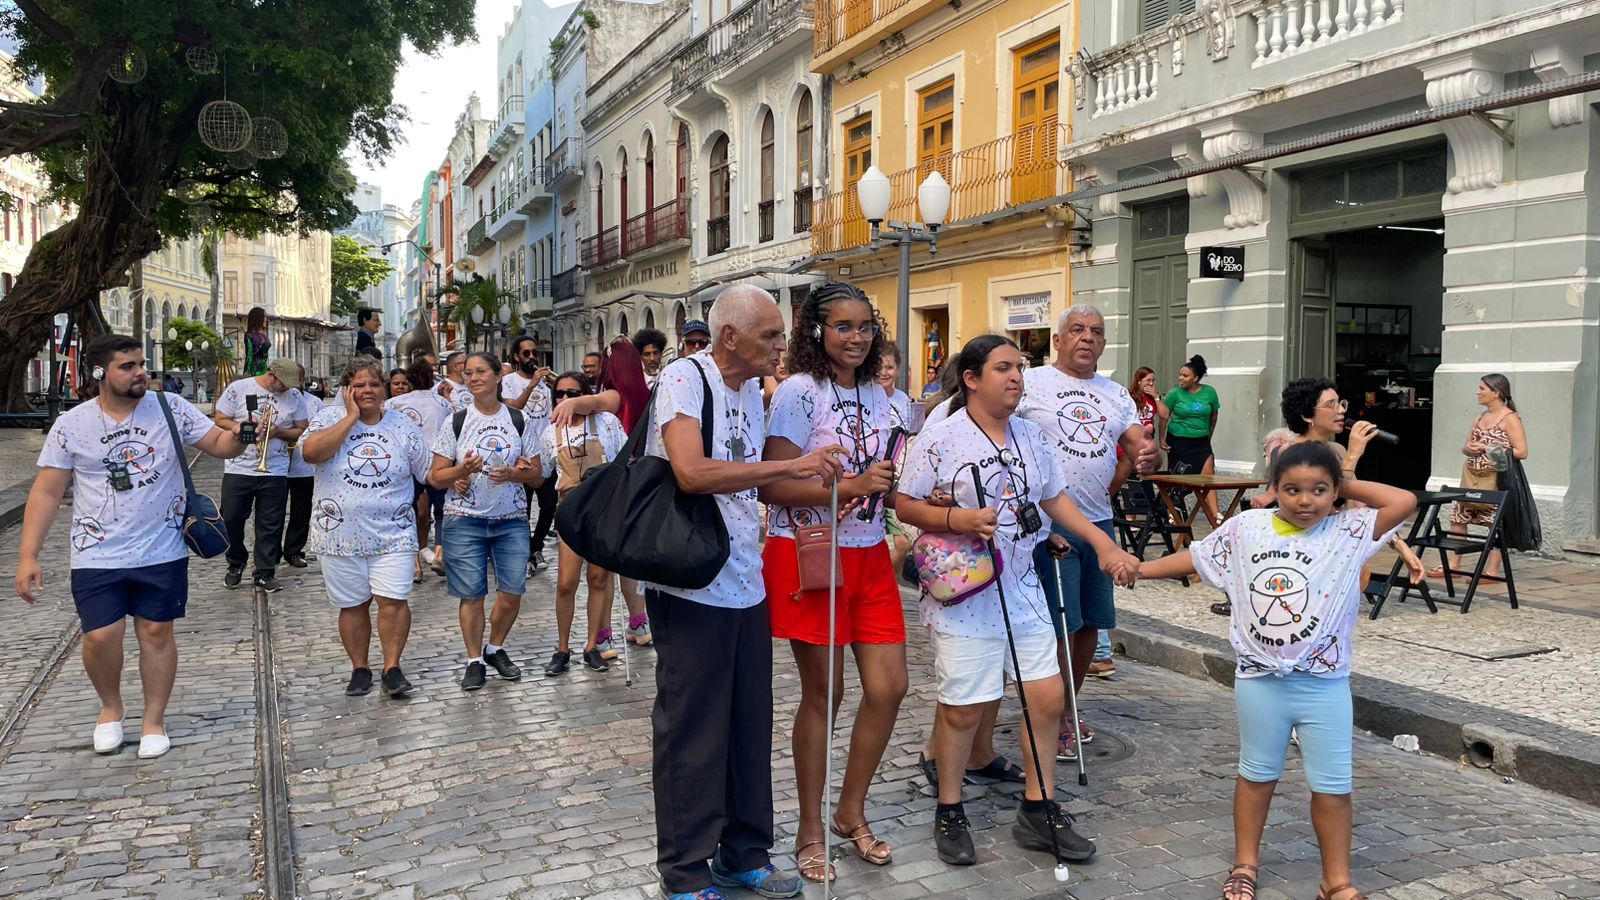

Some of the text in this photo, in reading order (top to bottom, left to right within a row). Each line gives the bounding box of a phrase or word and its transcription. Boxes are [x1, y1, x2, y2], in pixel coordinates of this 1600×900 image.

[1223, 256, 1235, 264] DO
[654, 260, 678, 280] ISRAEL
[1223, 263, 1243, 272] ZERO
[1056, 390, 1101, 404] Como Tu
[831, 400, 857, 412] Como
[100, 427, 148, 444] Como Tu
[478, 425, 508, 435] Como Tu
[350, 432, 389, 444] Como Tu
[1057, 439, 1109, 458] Tamo Aqui
[1012, 457, 1026, 468] Tu
[138, 470, 161, 488] Aqui
[343, 473, 392, 489] Tamo Aqui
[1251, 550, 1312, 565] Como Tu
[1249, 615, 1319, 646] Tamo Aqui
